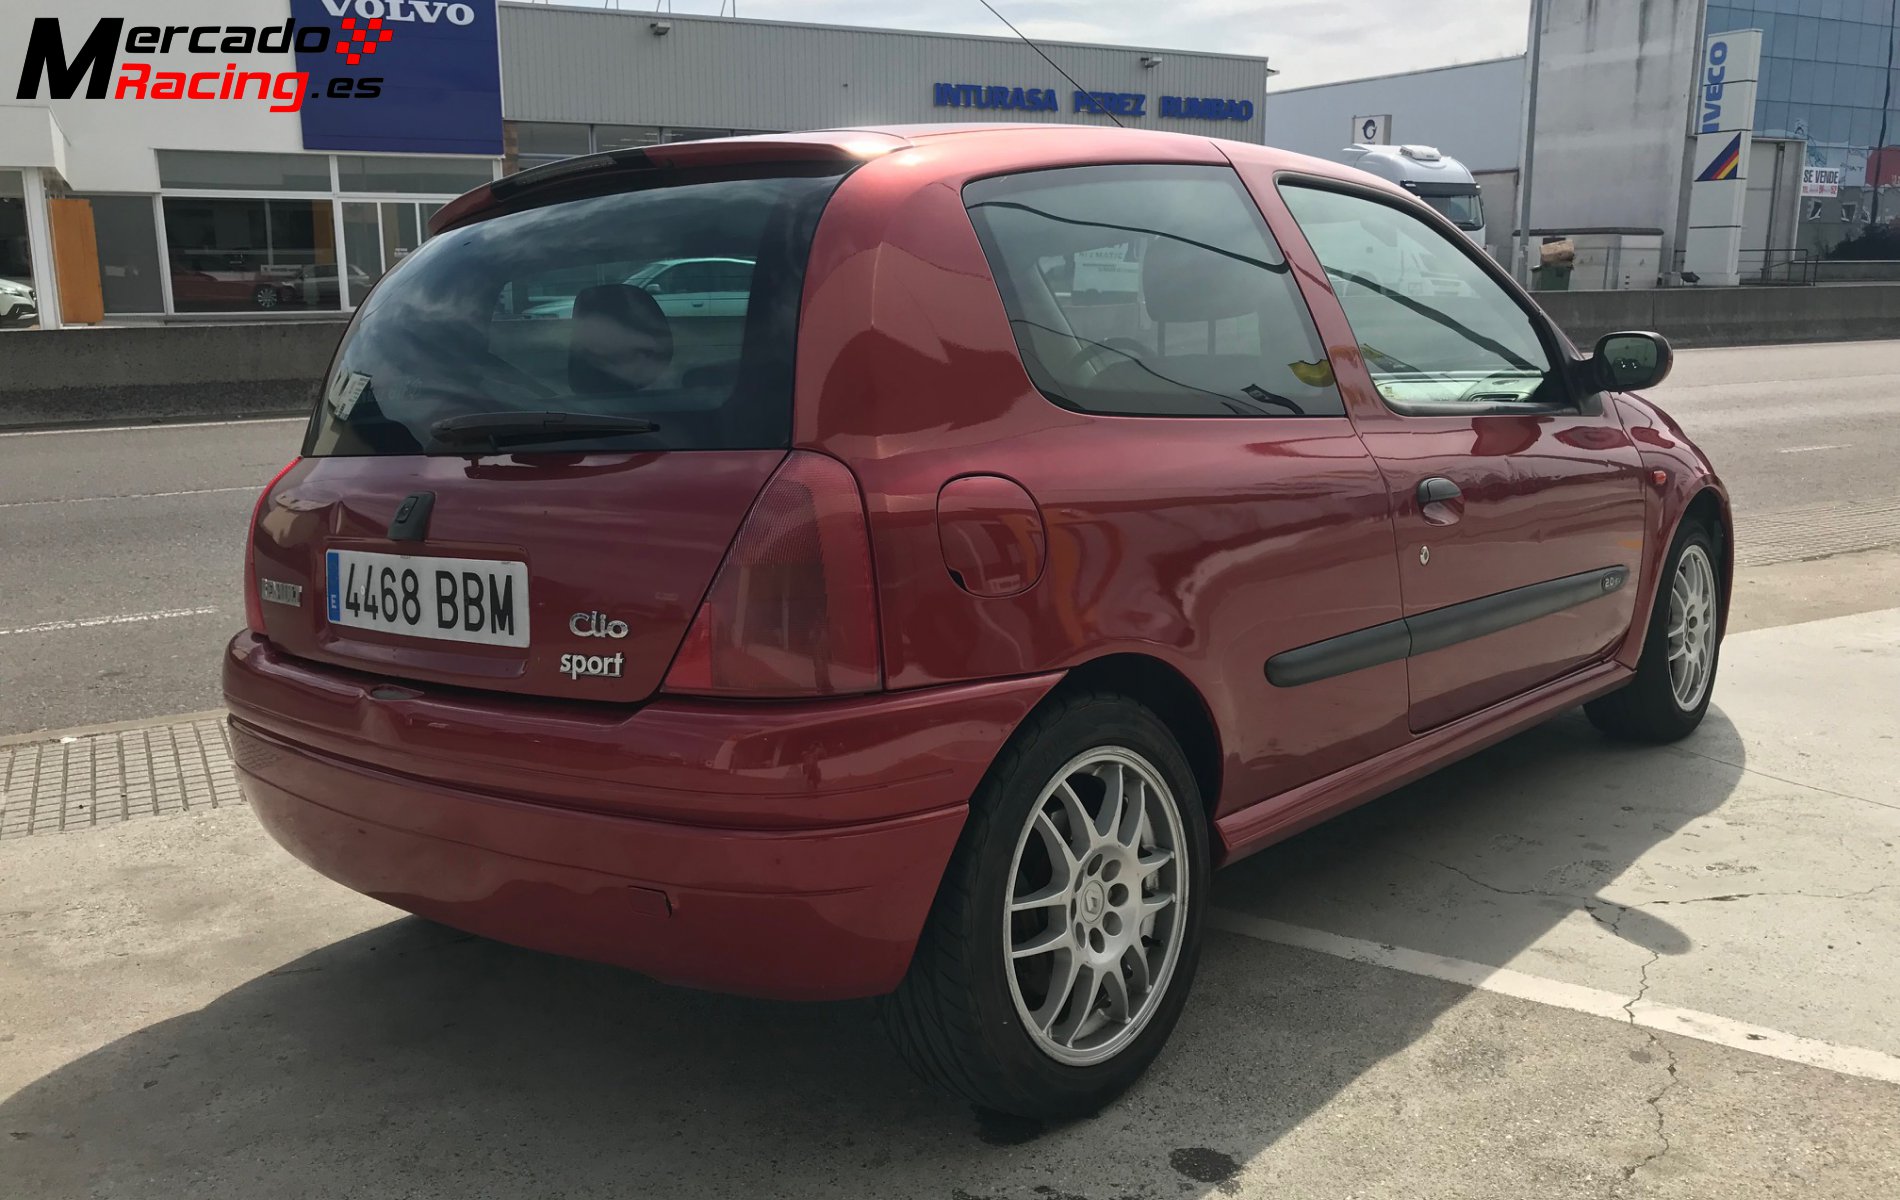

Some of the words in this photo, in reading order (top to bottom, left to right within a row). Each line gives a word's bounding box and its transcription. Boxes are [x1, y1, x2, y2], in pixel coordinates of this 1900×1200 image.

[321, 0, 475, 26] VOLVO
[1702, 41, 1728, 133] IVECO
[933, 82, 1059, 113] INTURASA
[1073, 90, 1147, 117] PEREZ
[1158, 95, 1254, 122] RUMBAO
[1803, 169, 1814, 183] SE
[1815, 170, 1839, 185] VENDE
[345, 563, 421, 626] 4468
[435, 570, 515, 636] BBM
[569, 611, 629, 639] Clio
[560, 652, 625, 680] sport
